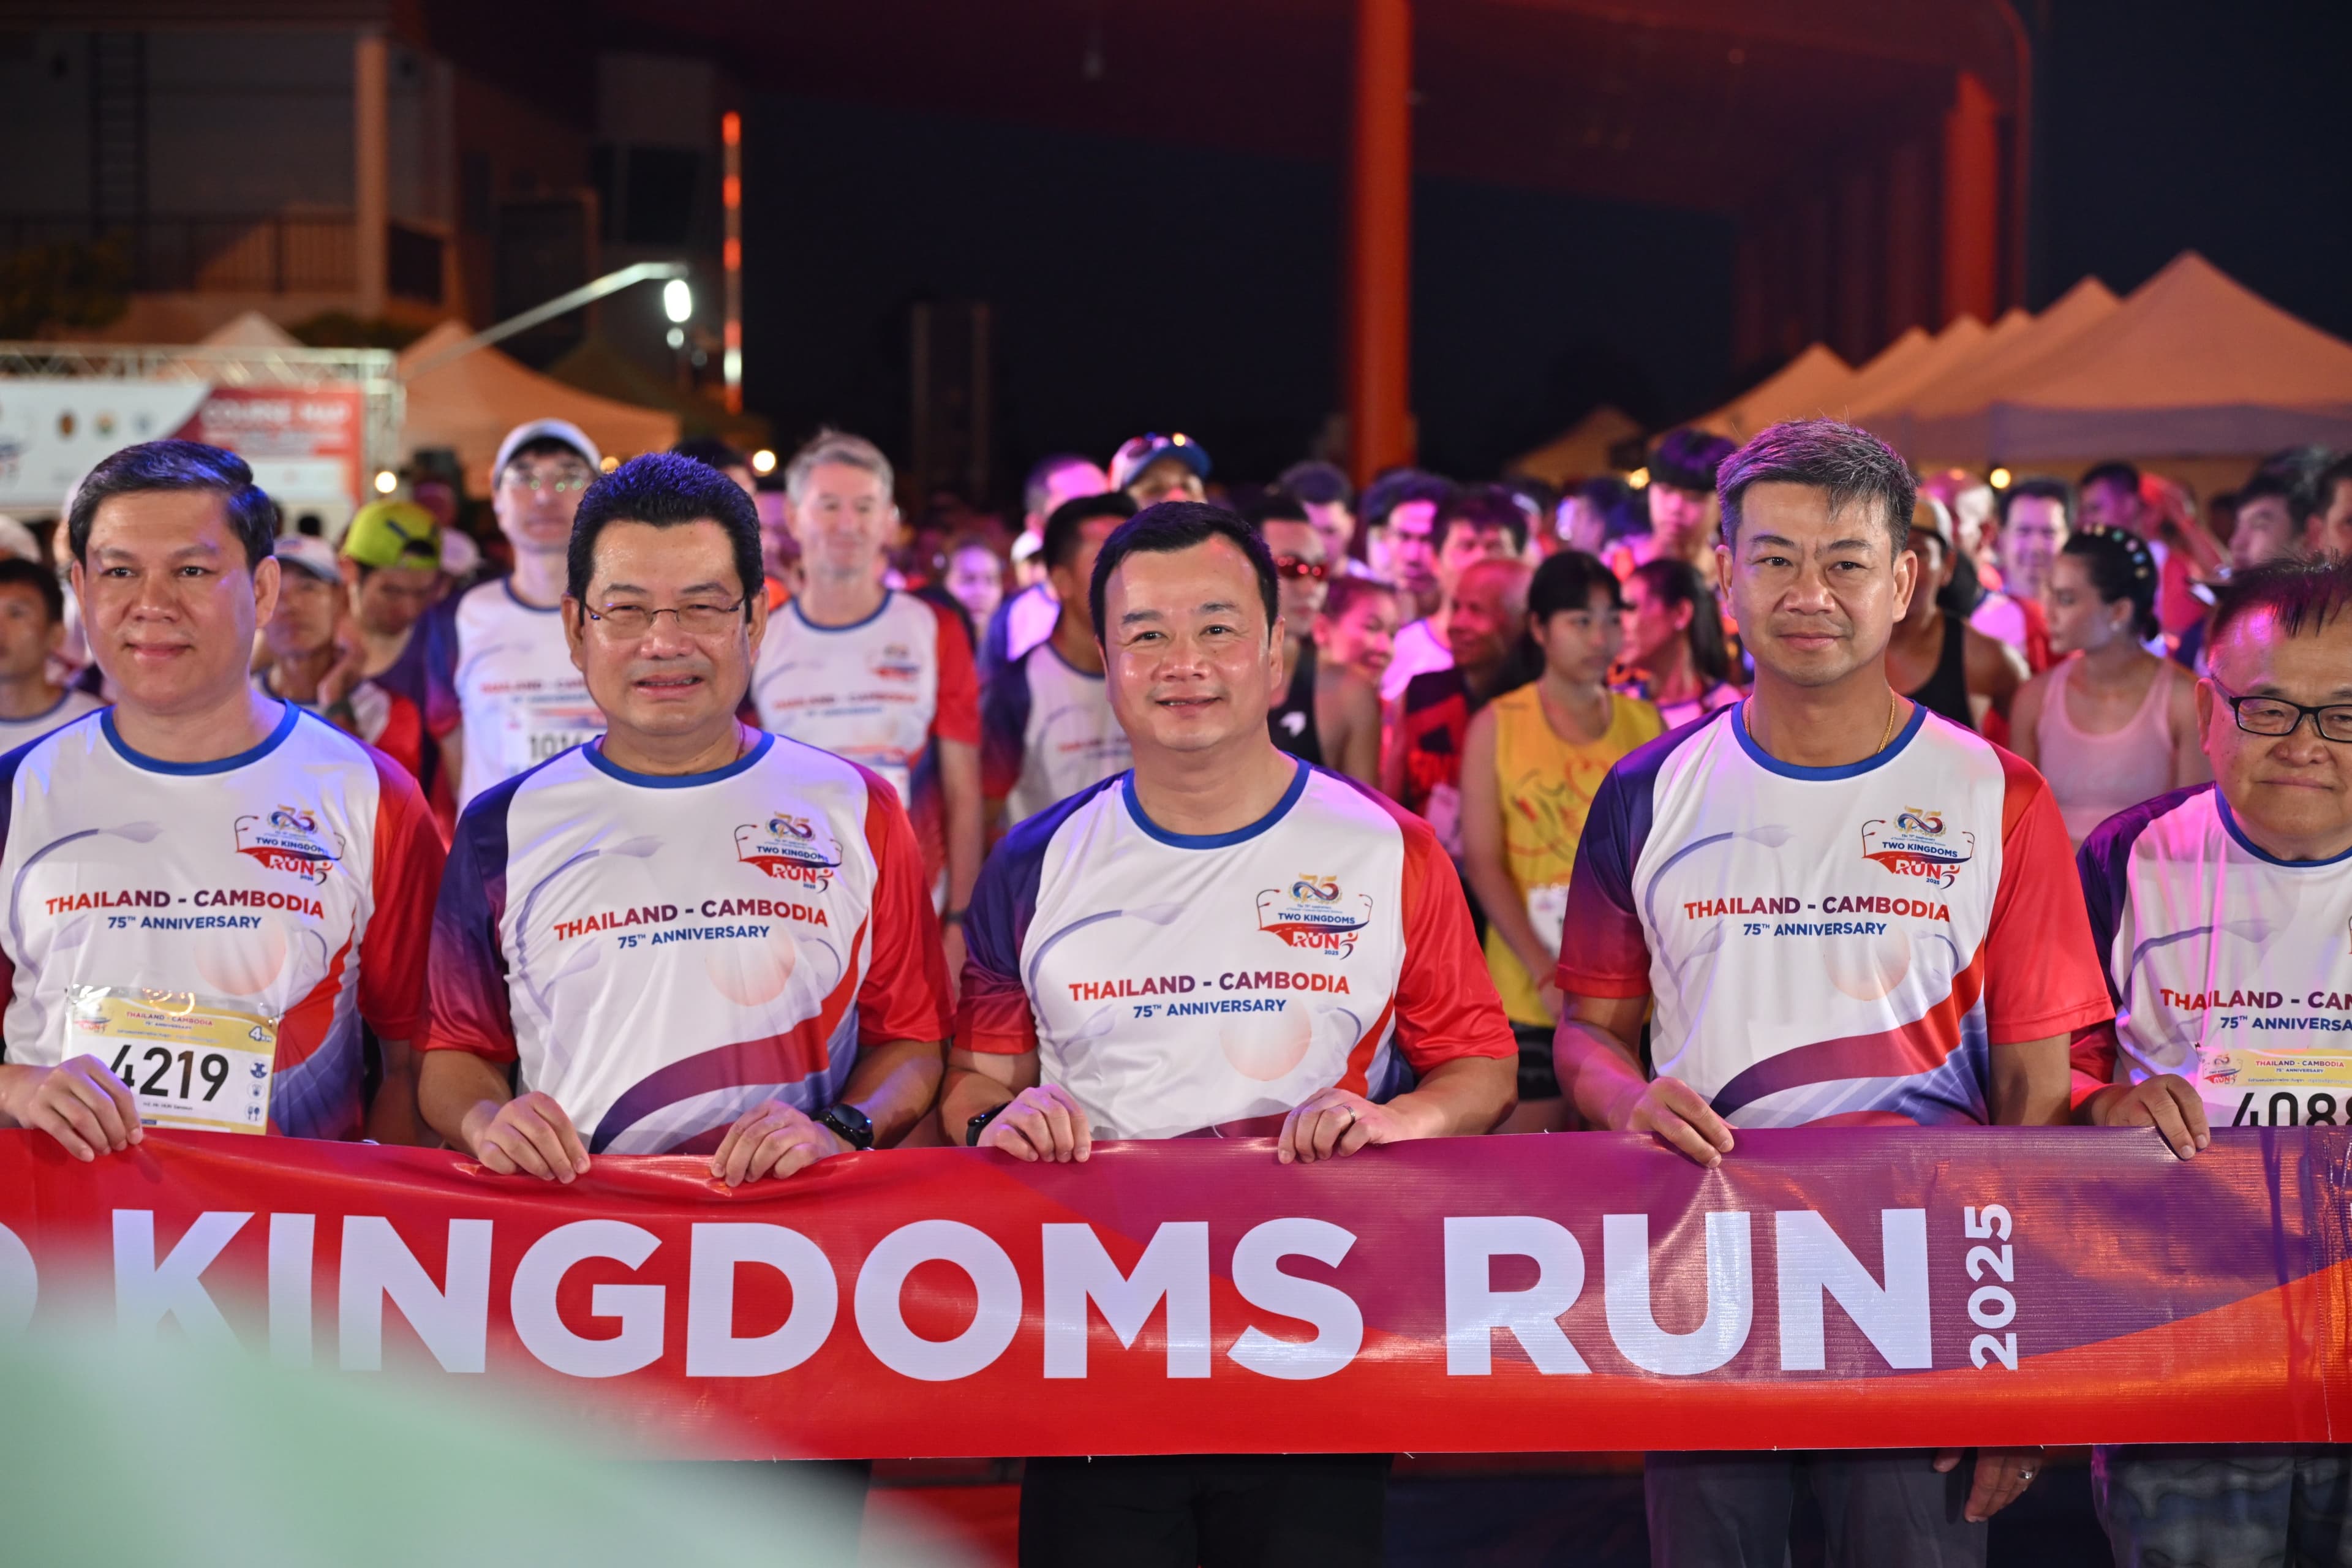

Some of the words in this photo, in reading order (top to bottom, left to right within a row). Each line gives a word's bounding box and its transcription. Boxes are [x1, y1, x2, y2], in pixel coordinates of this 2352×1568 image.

[255, 837, 278, 846] TWO
[756, 845, 779, 854] TWO
[1907, 843, 1958, 858] KINGDOMS
[269, 854, 314, 876] RUN
[771, 862, 816, 883] RUN
[1895, 859, 1942, 880] RUN
[45, 890, 171, 916] THAILAND
[194, 890, 324, 919] CAMBODIA
[1684, 897, 1801, 919] THAILAND
[1822, 896, 1950, 922] CAMBODIA
[140, 916, 262, 930] ANNIVERSARY
[553, 904, 678, 941] THAILAND
[701, 899, 829, 927] CAMBODIA
[1304, 914, 1355, 924] KINGDOMS
[1774, 922, 1887, 937] ANNIVERSARY
[651, 925, 770, 945] ANNIVERSARY
[1291, 931, 1340, 949] RUN
[1068, 975, 1196, 1001] THAILAND
[1219, 971, 1350, 995] CAMBODIA
[1166, 999, 1287, 1016] ANNIVERSARY
[2160, 989, 2283, 1011] THAILAND
[172, 1017, 213, 1026] CAMBODIA
[110, 1044, 229, 1101] 4219
[2231, 1091, 2352, 1127] 408
[112, 1208, 1363, 1381] KINGDOMS
[1443, 1208, 1933, 1377] RUN
[1964, 1203, 2019, 1371] 2025
